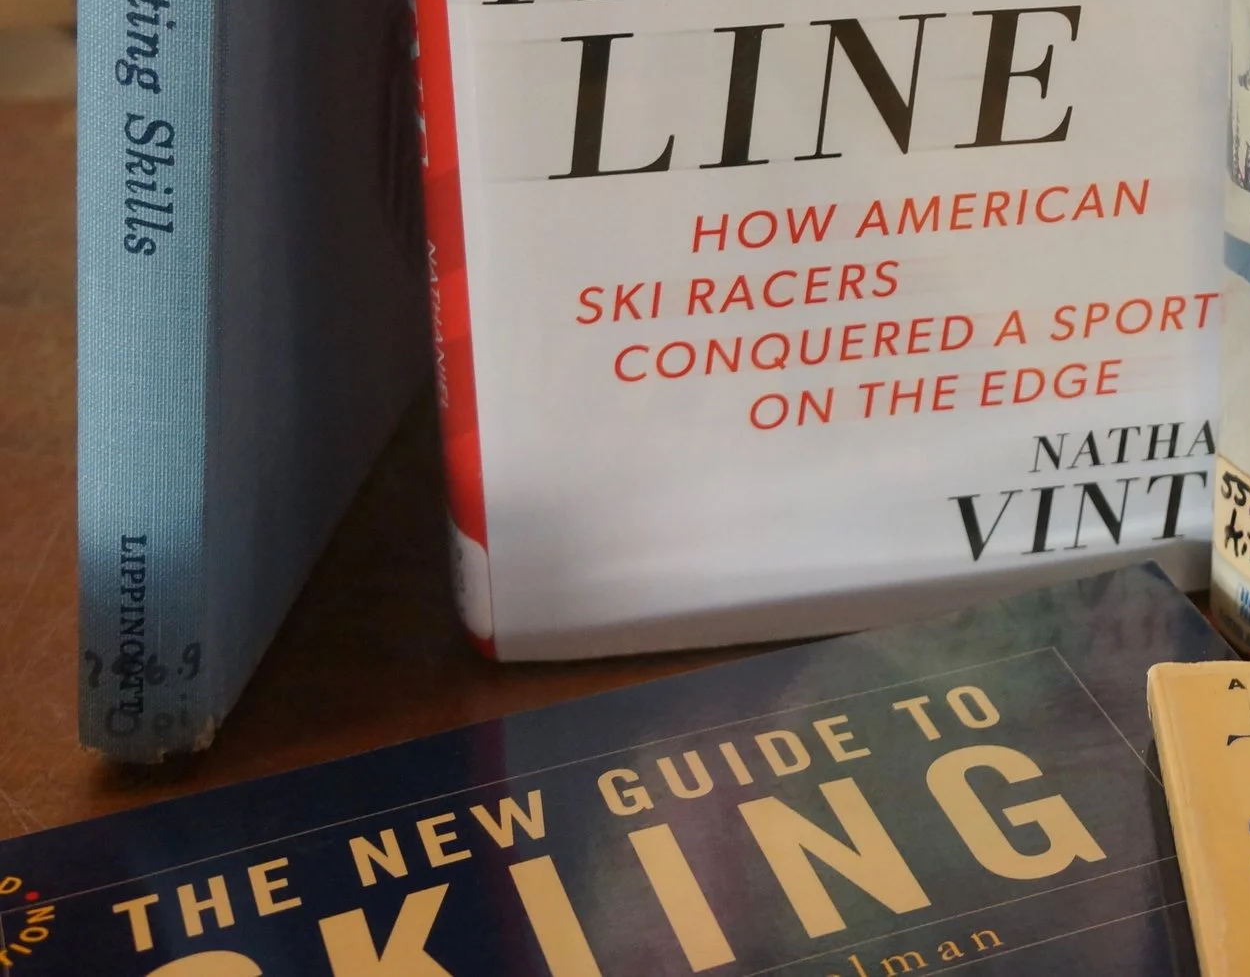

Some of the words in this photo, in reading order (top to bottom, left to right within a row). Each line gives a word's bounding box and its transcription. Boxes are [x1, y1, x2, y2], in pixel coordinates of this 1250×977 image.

[547, 5, 1081, 180] LINE
[123, 114, 175, 256] Skills
[691, 204, 838, 254] HOW
[855, 179, 1151, 240] AMERICAN
[576, 281, 662, 324] SKI
[687, 260, 900, 317] RACERS
[614, 315, 974, 383] CONQUERED
[994, 309, 1027, 348] A
[1050, 293, 1220, 341] SPORT
[749, 388, 835, 431] ON
[858, 375, 959, 420] THE
[979, 359, 1124, 408] EDGE
[1028, 419, 1217, 474] NATHA
[948, 471, 1209, 563] VINT
[119, 534, 148, 715] LIPPINCOTT
[1228, 678, 1247, 691] A
[112, 857, 302, 953] THE
[347, 789, 547, 888] NEW
[597, 714, 871, 816] GUIDE
[892, 684, 1001, 742] TO
[143, 744, 1107, 977] KIING
[824, 928, 1005, 977] lman
